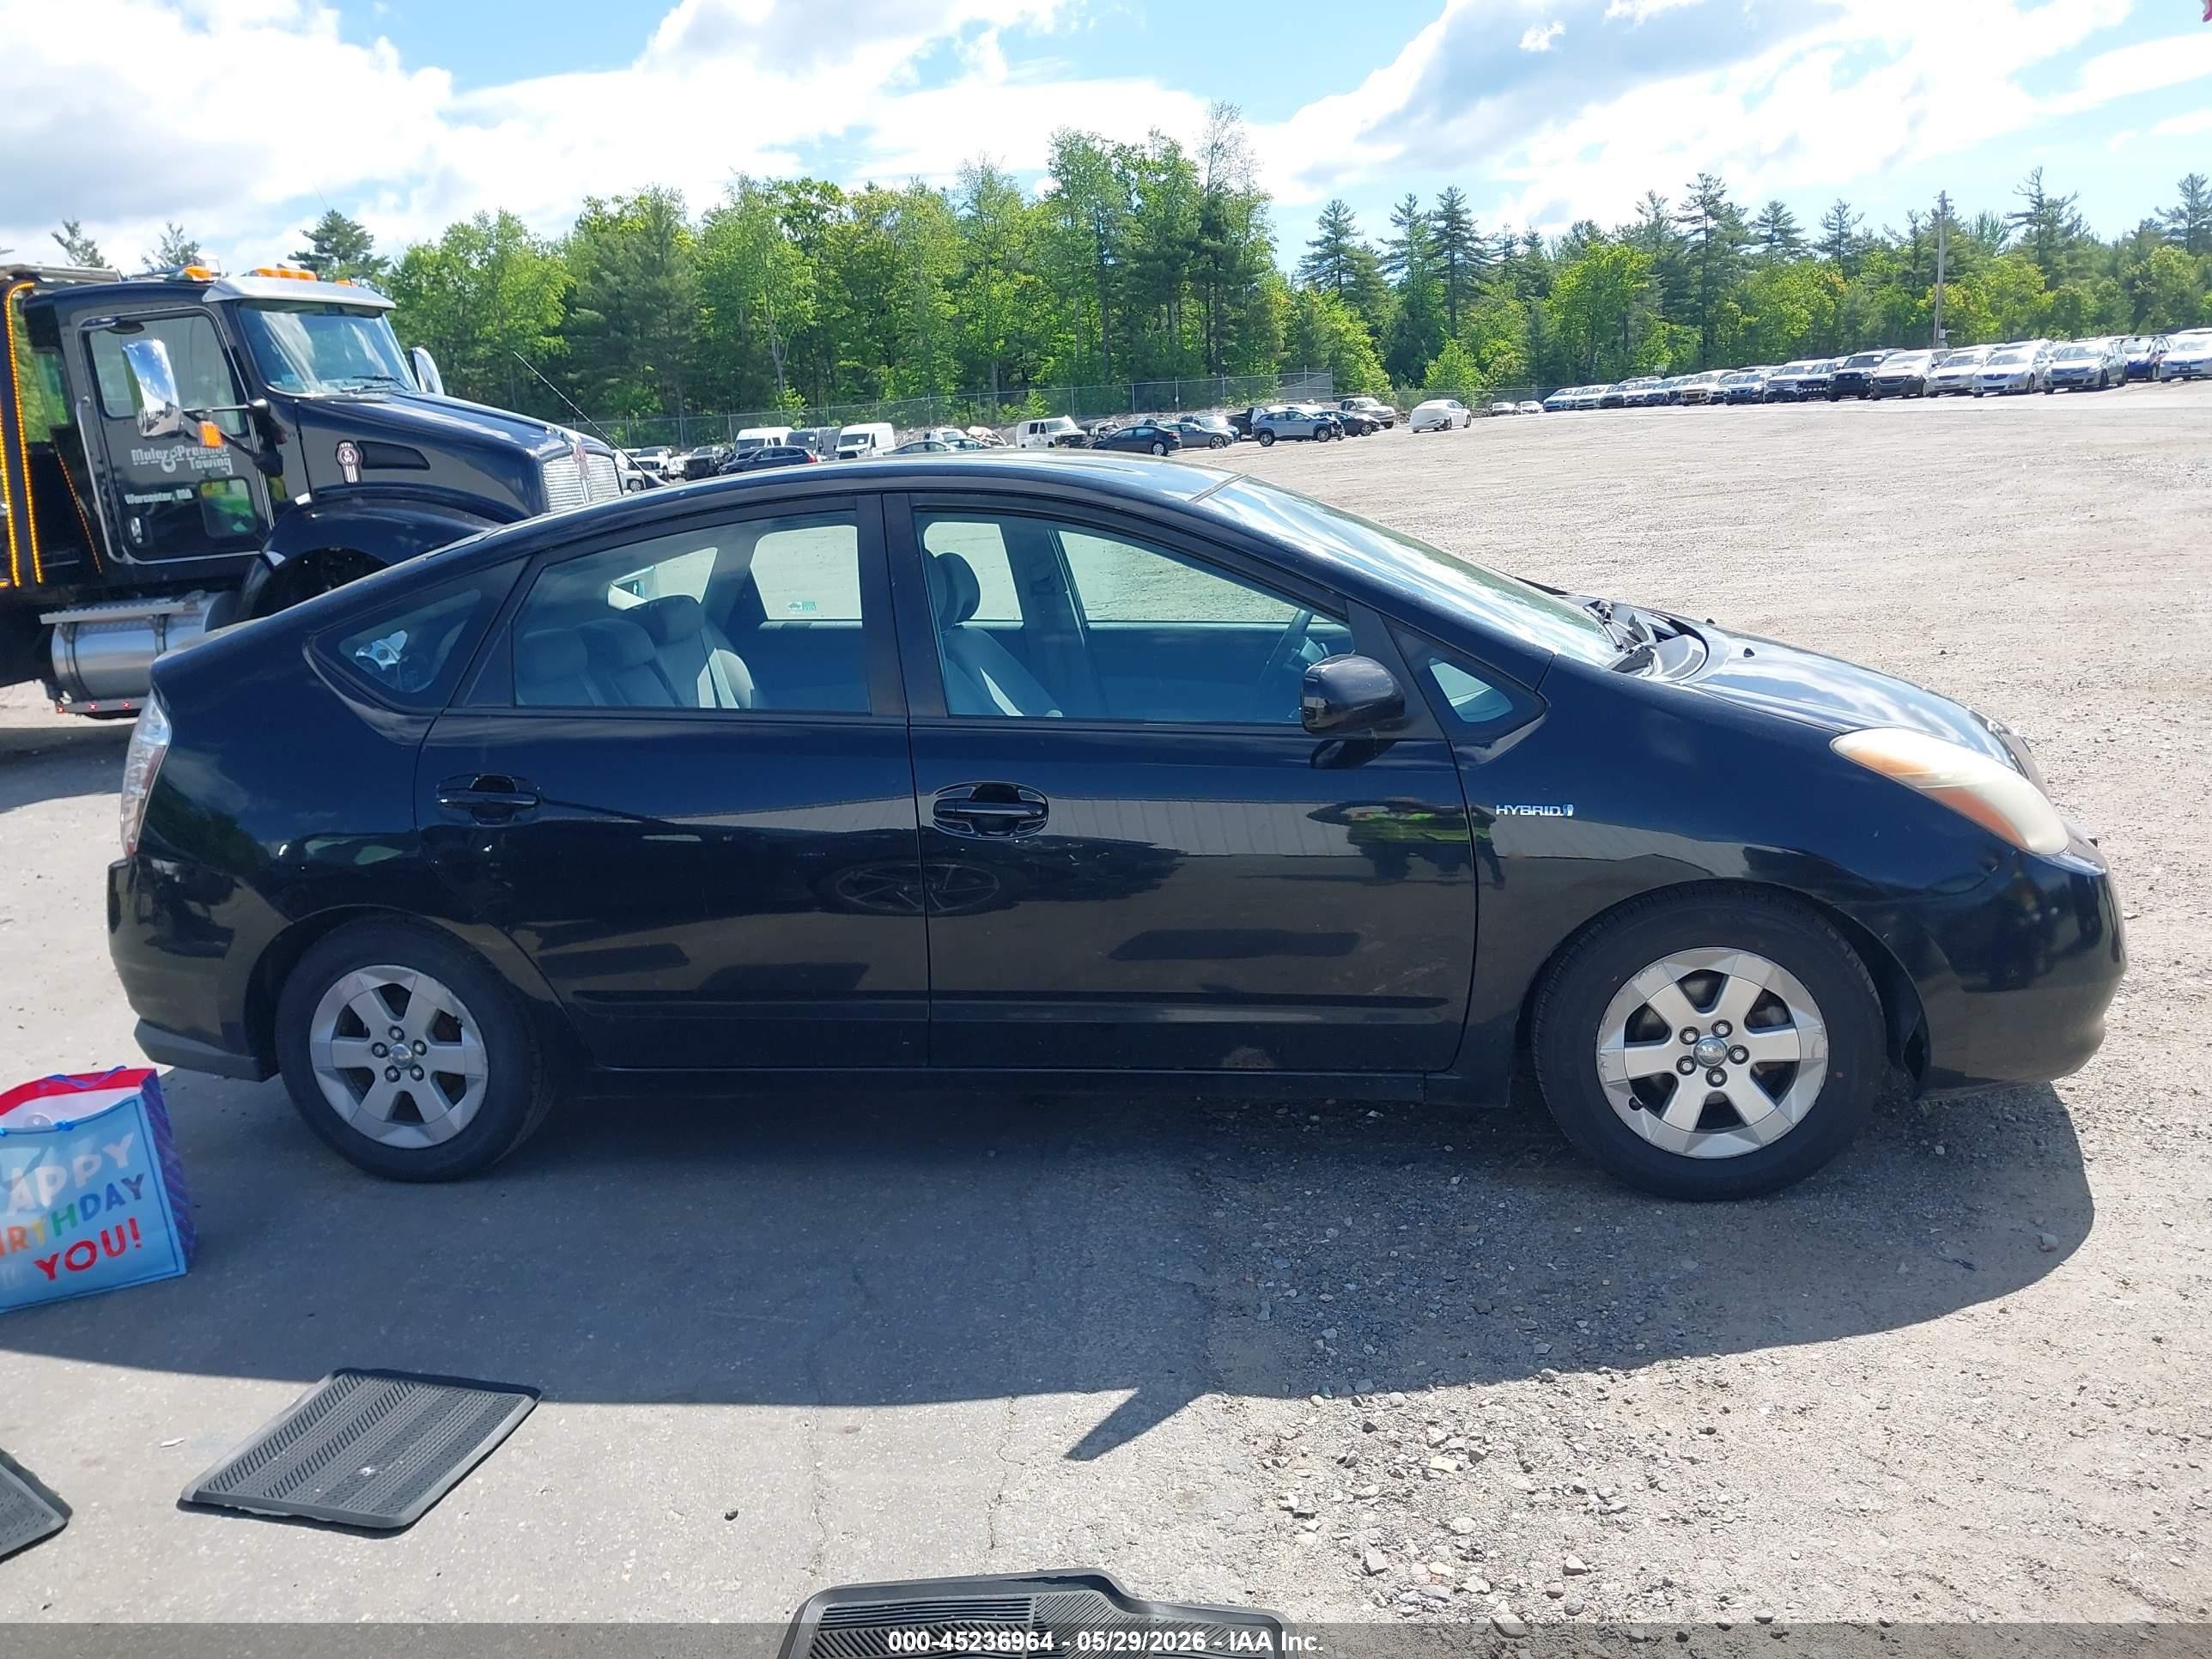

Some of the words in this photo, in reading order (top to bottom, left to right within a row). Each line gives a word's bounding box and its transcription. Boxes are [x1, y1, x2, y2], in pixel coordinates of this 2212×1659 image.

[187, 456, 234, 476] Towing
[1496, 804, 1563, 816] HYBRID
[34, 1217, 143, 1281] YOU!
